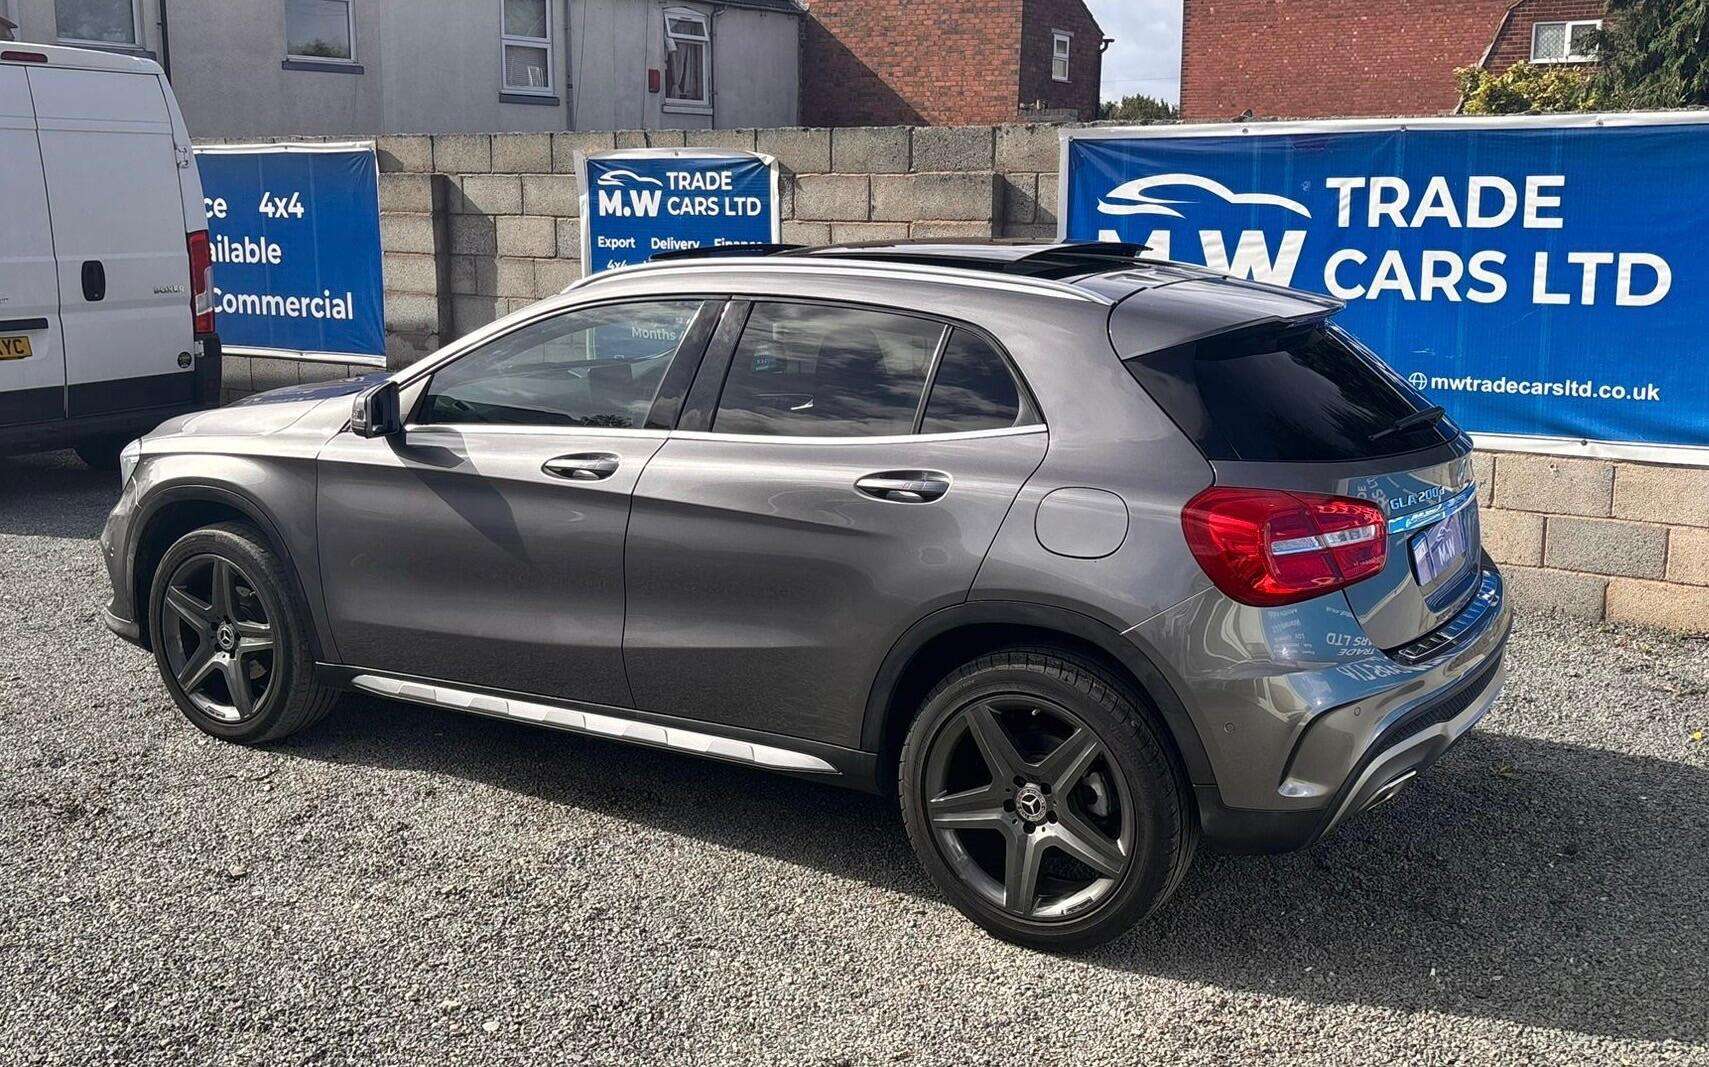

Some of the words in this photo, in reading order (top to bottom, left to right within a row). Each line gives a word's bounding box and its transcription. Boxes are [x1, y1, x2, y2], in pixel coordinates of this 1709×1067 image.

[666, 171, 733, 190] TRADE
[203, 197, 228, 218] ce
[259, 191, 305, 218] 4x4
[598, 189, 662, 217] M.W
[667, 197, 720, 216] CARS
[725, 197, 762, 216] LTD
[1325, 175, 1567, 229] TRADE
[209, 234, 282, 265] ailable
[597, 236, 635, 251] Export
[651, 236, 701, 250] Delivery
[1323, 249, 1509, 303] CARS
[1533, 251, 1674, 307] LTD
[212, 287, 354, 320] Commercial
[0, 338, 25, 355] YC
[631, 326, 677, 341] Months
[1430, 375, 1661, 401] mwtradecarsltd.co.uk
[1389, 494, 1416, 510] GLA
[1354, 636, 1373, 646] ARS
